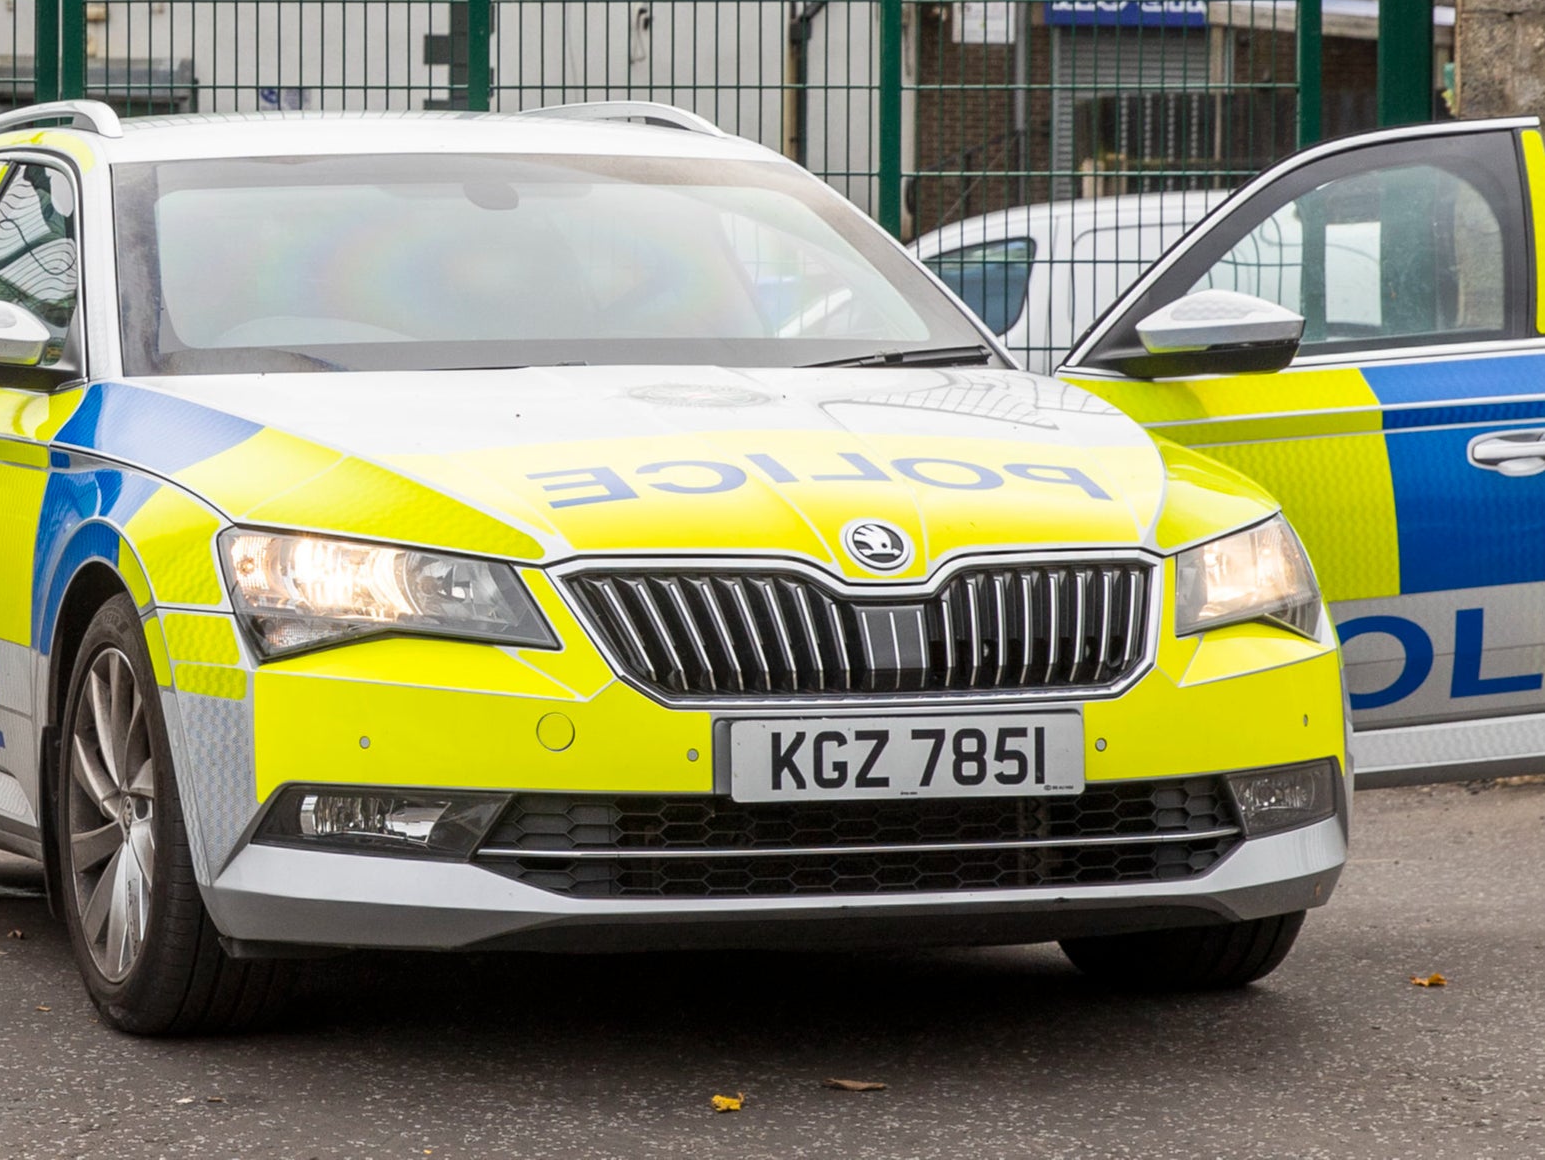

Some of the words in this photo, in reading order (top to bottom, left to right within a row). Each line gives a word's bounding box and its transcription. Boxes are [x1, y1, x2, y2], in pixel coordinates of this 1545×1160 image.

[1336, 608, 1544, 710] OL
[771, 729, 890, 791] KGZ
[911, 726, 1046, 788] 7851
